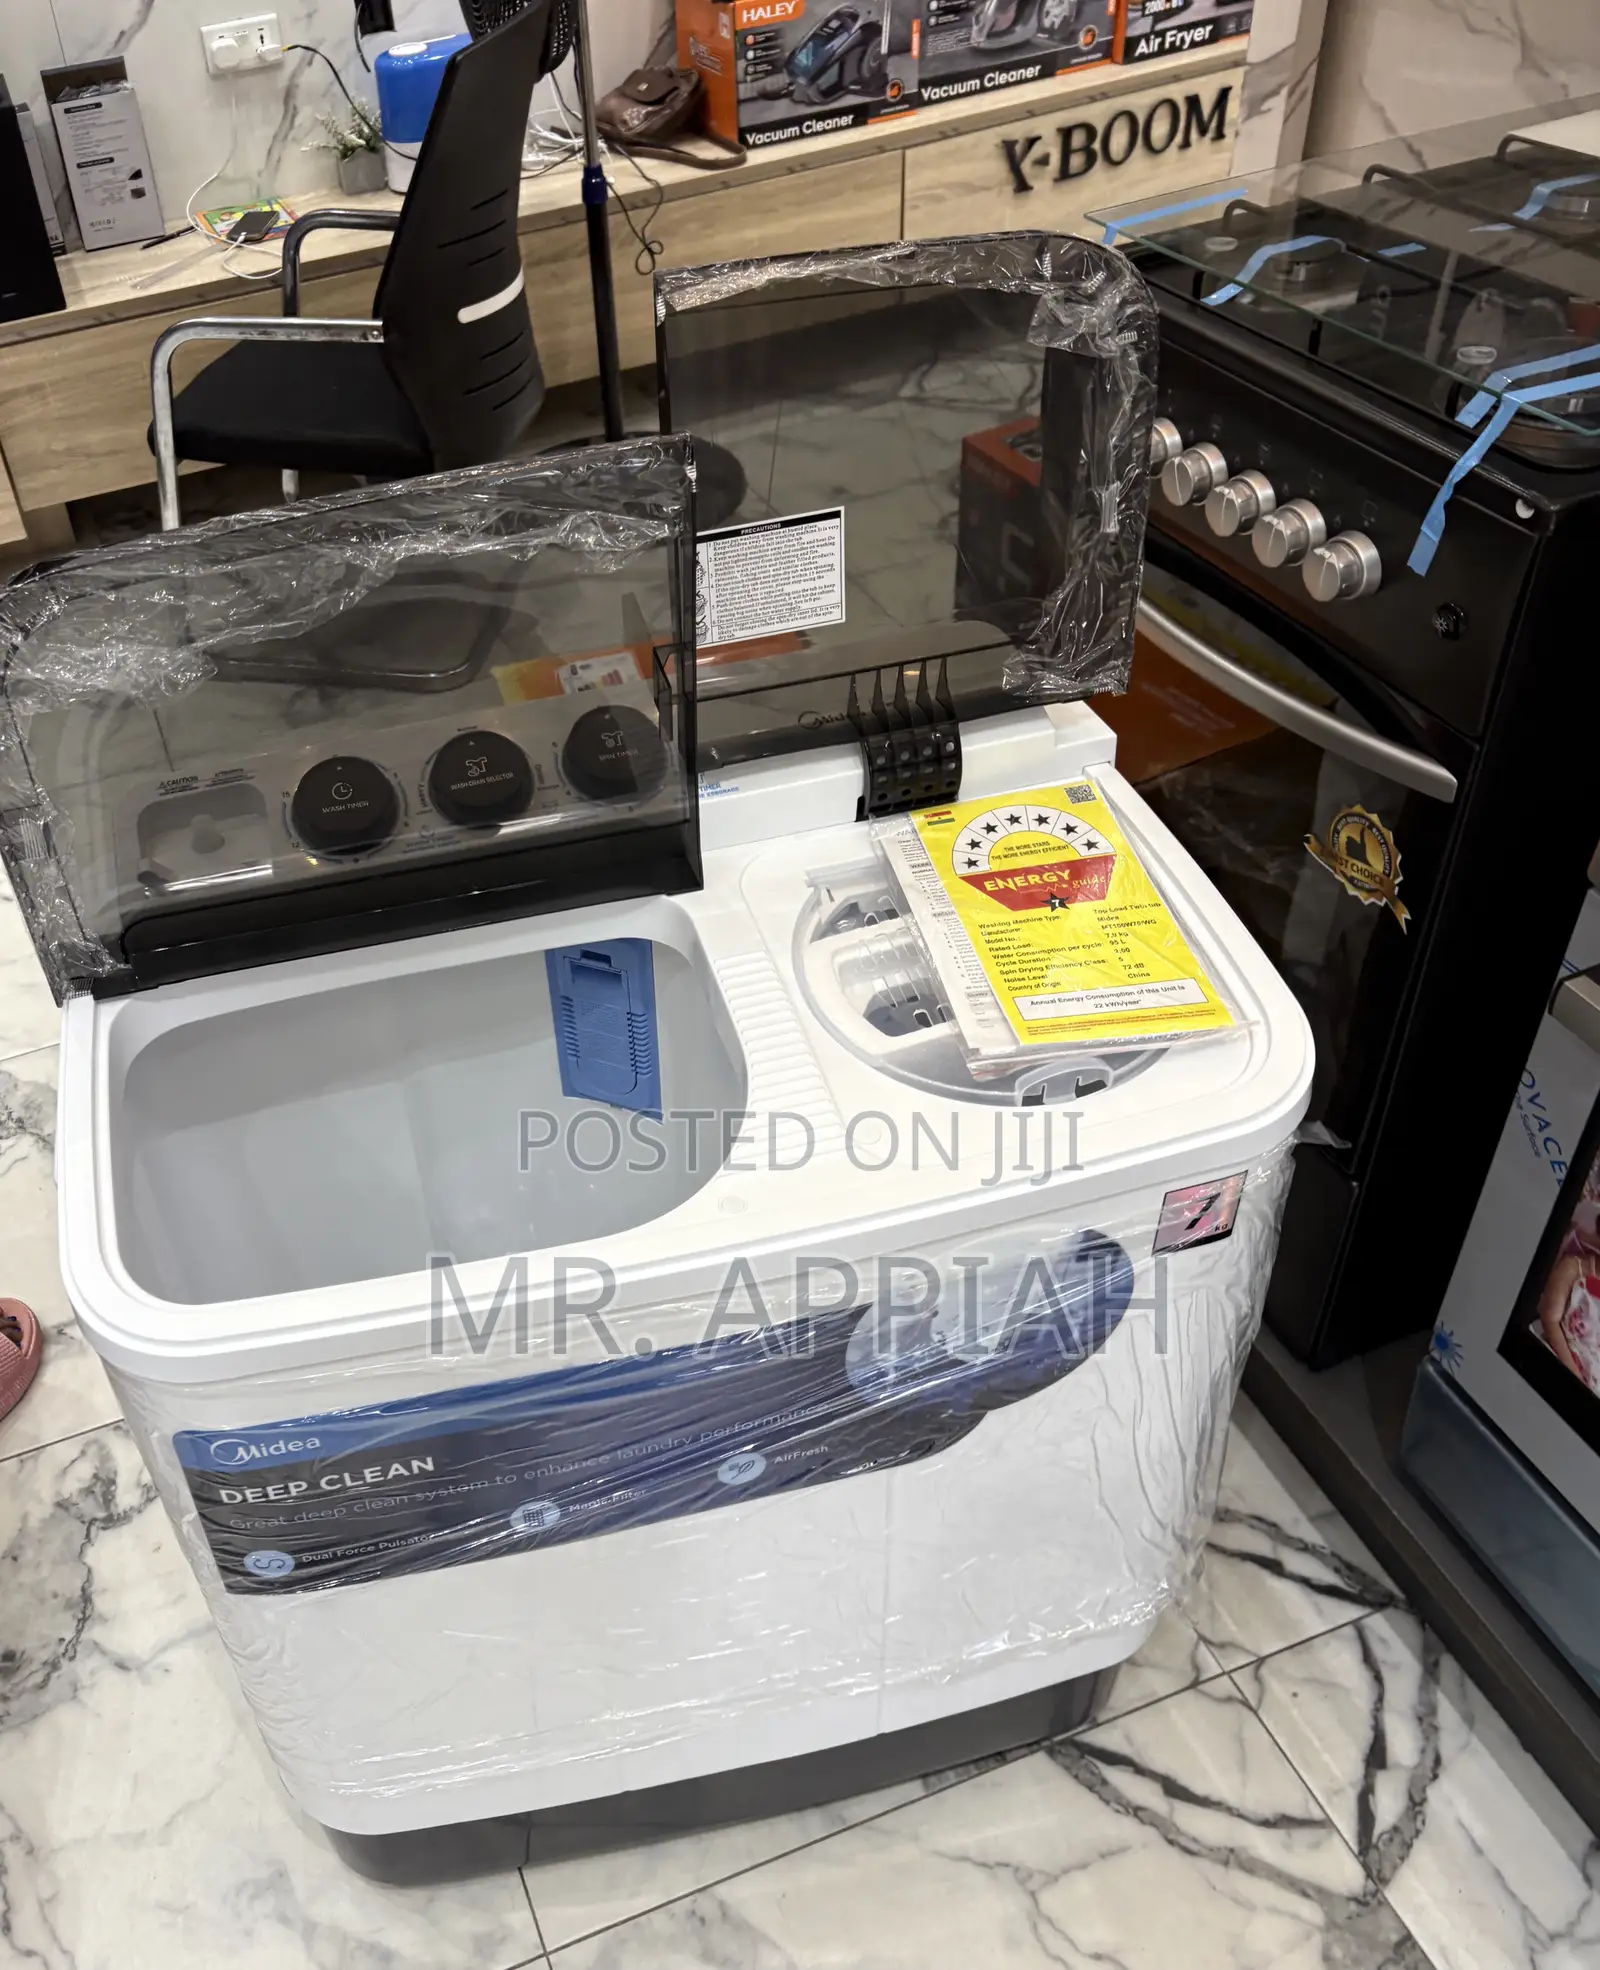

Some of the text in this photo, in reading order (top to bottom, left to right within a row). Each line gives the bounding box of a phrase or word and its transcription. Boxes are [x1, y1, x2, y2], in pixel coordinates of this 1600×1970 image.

[742, 0, 796, 23] HALEY
[1135, 23, 1213, 57] Air Fryer
[920, 64, 1042, 101] Vacuum Cleaner
[745, 113, 854, 146] Vacuum Cleaner
[740, 522, 782, 535] PRECAUTIONS
[322, 800, 370, 814] WASH TIMER
[1042, 845, 1070, 853] EFFICIENT
[984, 870, 1071, 892] ENERGY
[978, 920, 1011, 930] Washing
[1012, 916, 1042, 925] Machine
[1015, 946, 1066, 958] Consumption
[999, 968, 1017, 976] Spin
[1019, 965, 1044, 974] Drying
[1045, 960, 1083, 972] Efficiency
[1008, 984, 1033, 992] Country
[1030, 997, 1057, 1007] Annual
[1057, 994, 1084, 1004] Energy
[1085, 990, 1136, 1002] Consumption
[1145, 987, 1160, 995] this
[1160, 985, 1176, 994] Unit
[1184, 1192, 1222, 1231] 7
[210, 1435, 321, 1466] Midea
[774, 1444, 829, 1465] AirFresh
[218, 1456, 436, 1505] DEEP CLEAN
[229, 1513, 288, 1531] Great
[293, 1504, 347, 1525] deep
[353, 1493, 409, 1513] clean
[414, 1480, 490, 1503] system
[495, 1472, 517, 1486] to
[523, 1453, 610, 1481] enhance
[616, 1434, 694, 1461] laundry
[302, 1533, 436, 1564] Dual Force Pulsator
